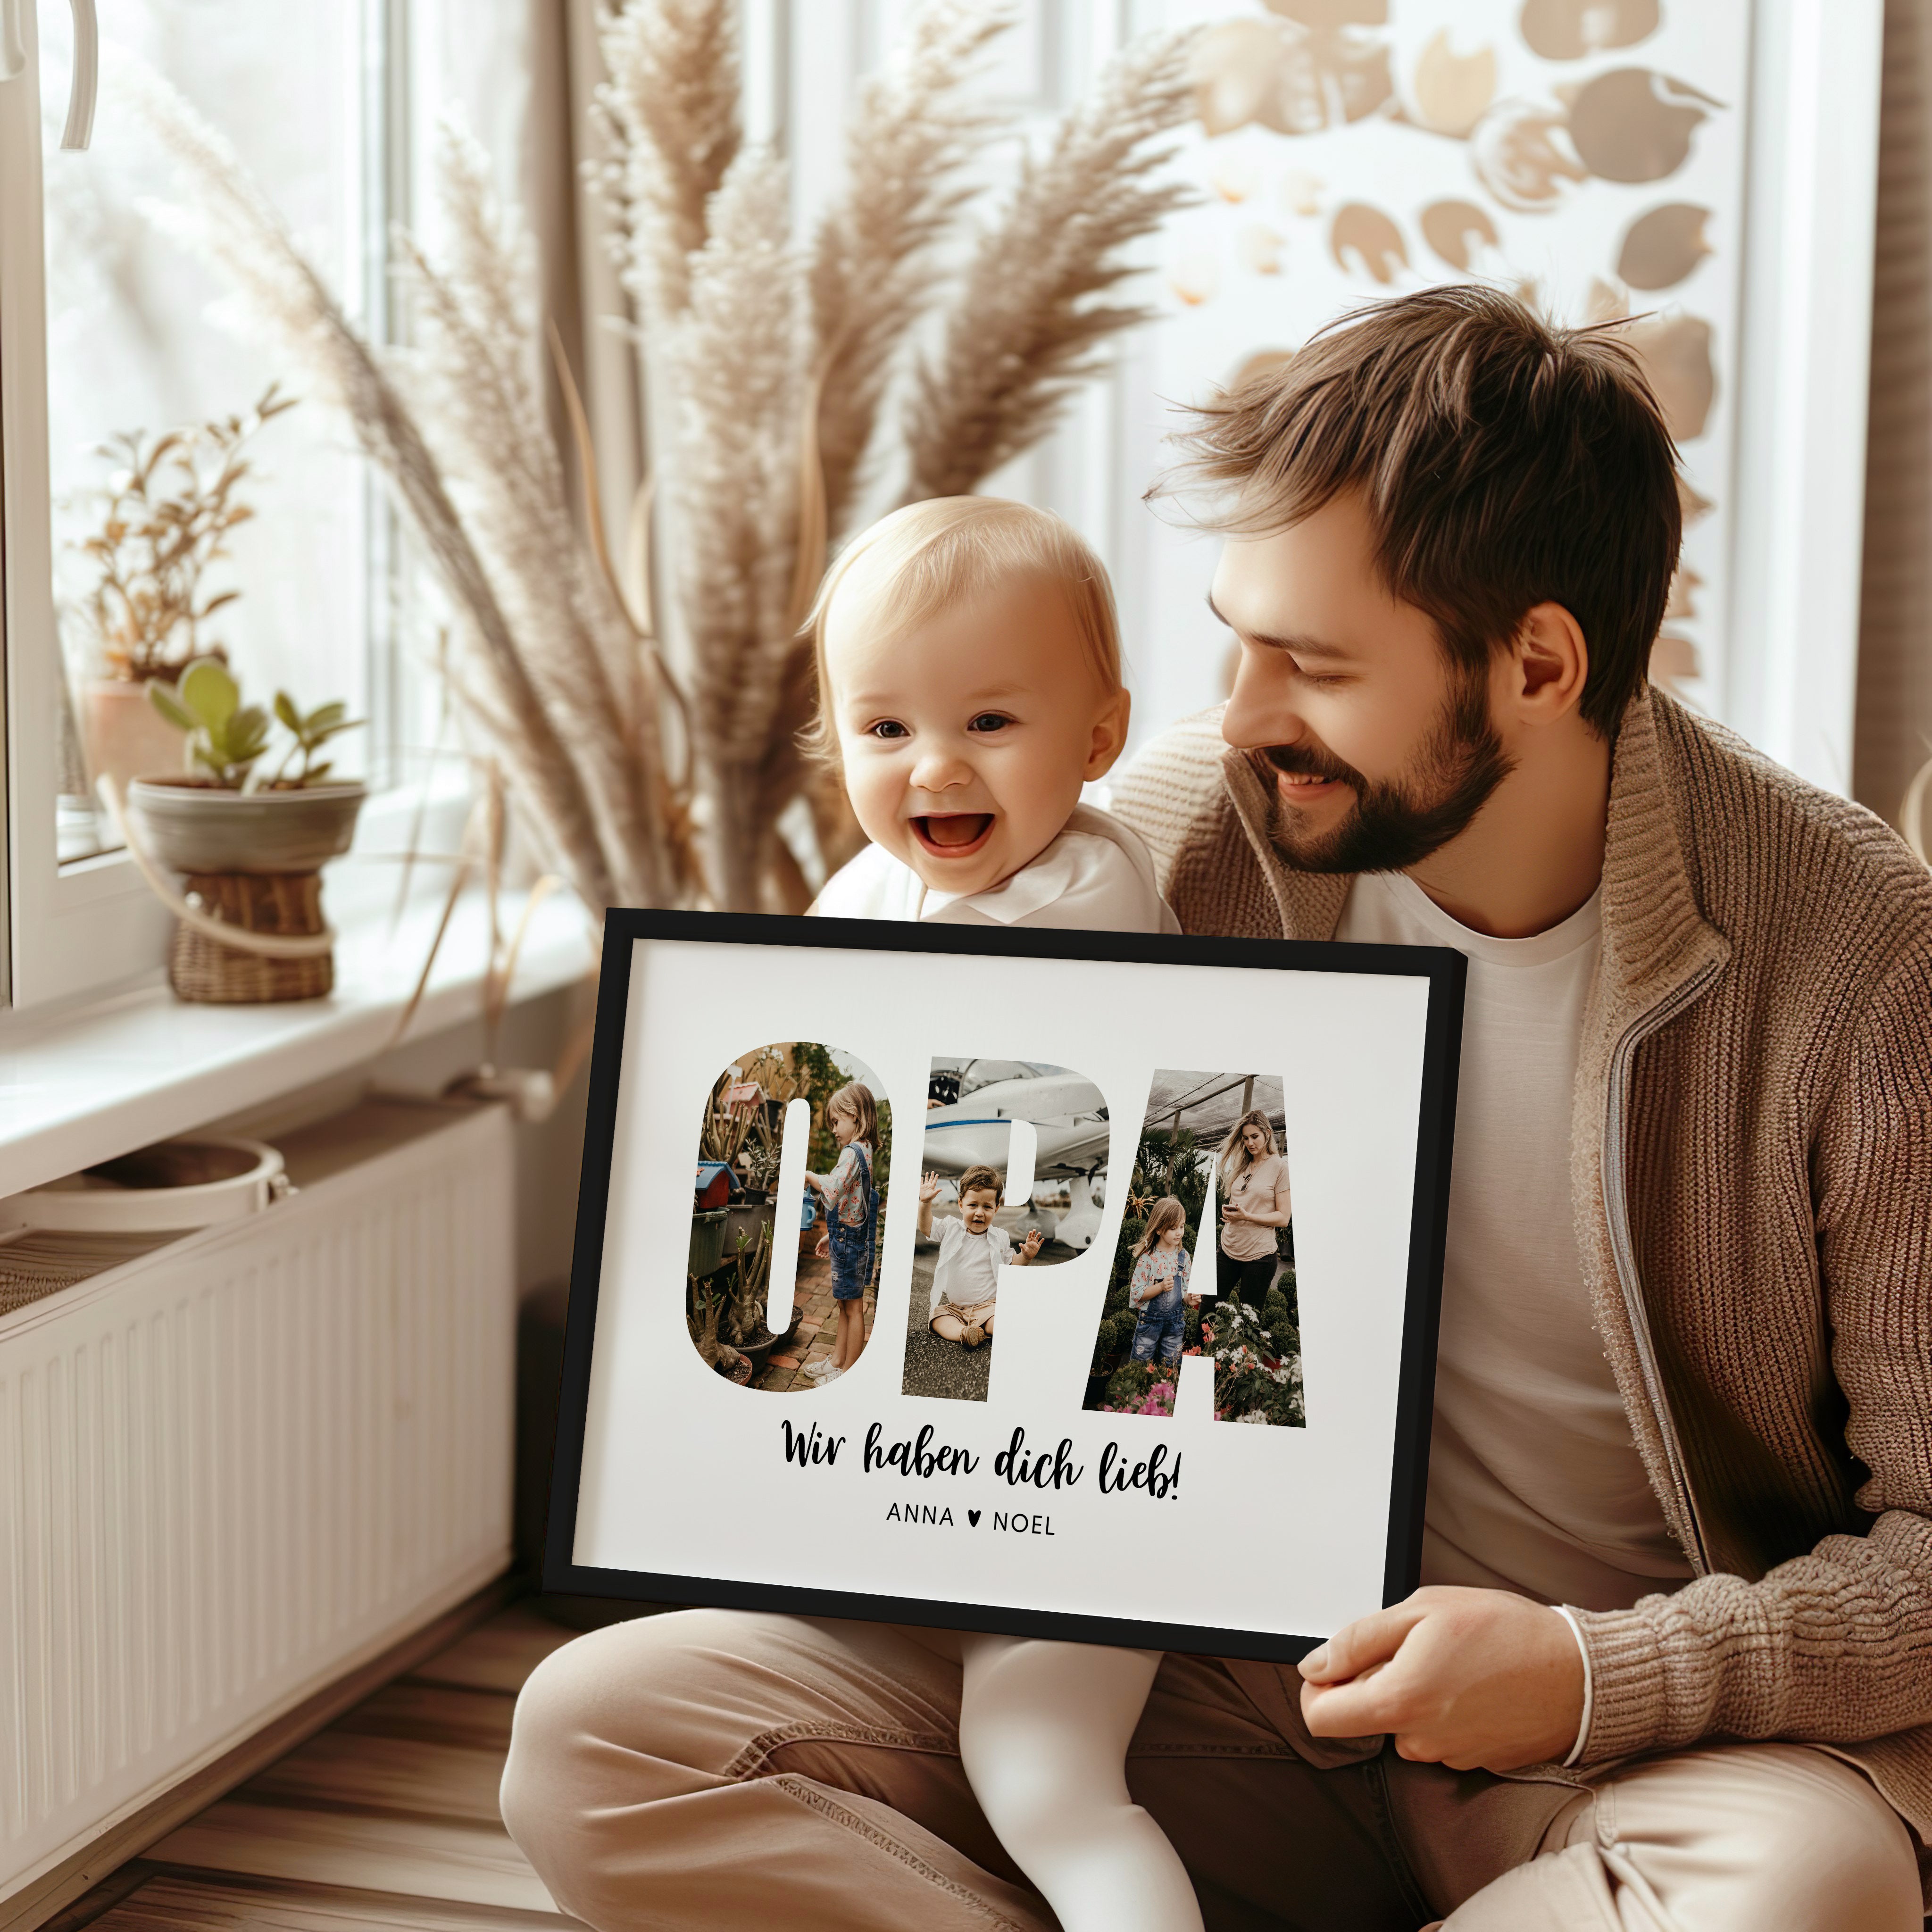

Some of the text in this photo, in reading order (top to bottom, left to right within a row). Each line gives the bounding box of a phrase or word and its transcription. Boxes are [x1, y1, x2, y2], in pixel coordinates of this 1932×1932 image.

[686, 1041, 1306, 1428] OPA
[781, 1419, 1182, 1500] Wir haben dich lieb!
[886, 1502, 1055, 1536] ANNA NOEL
